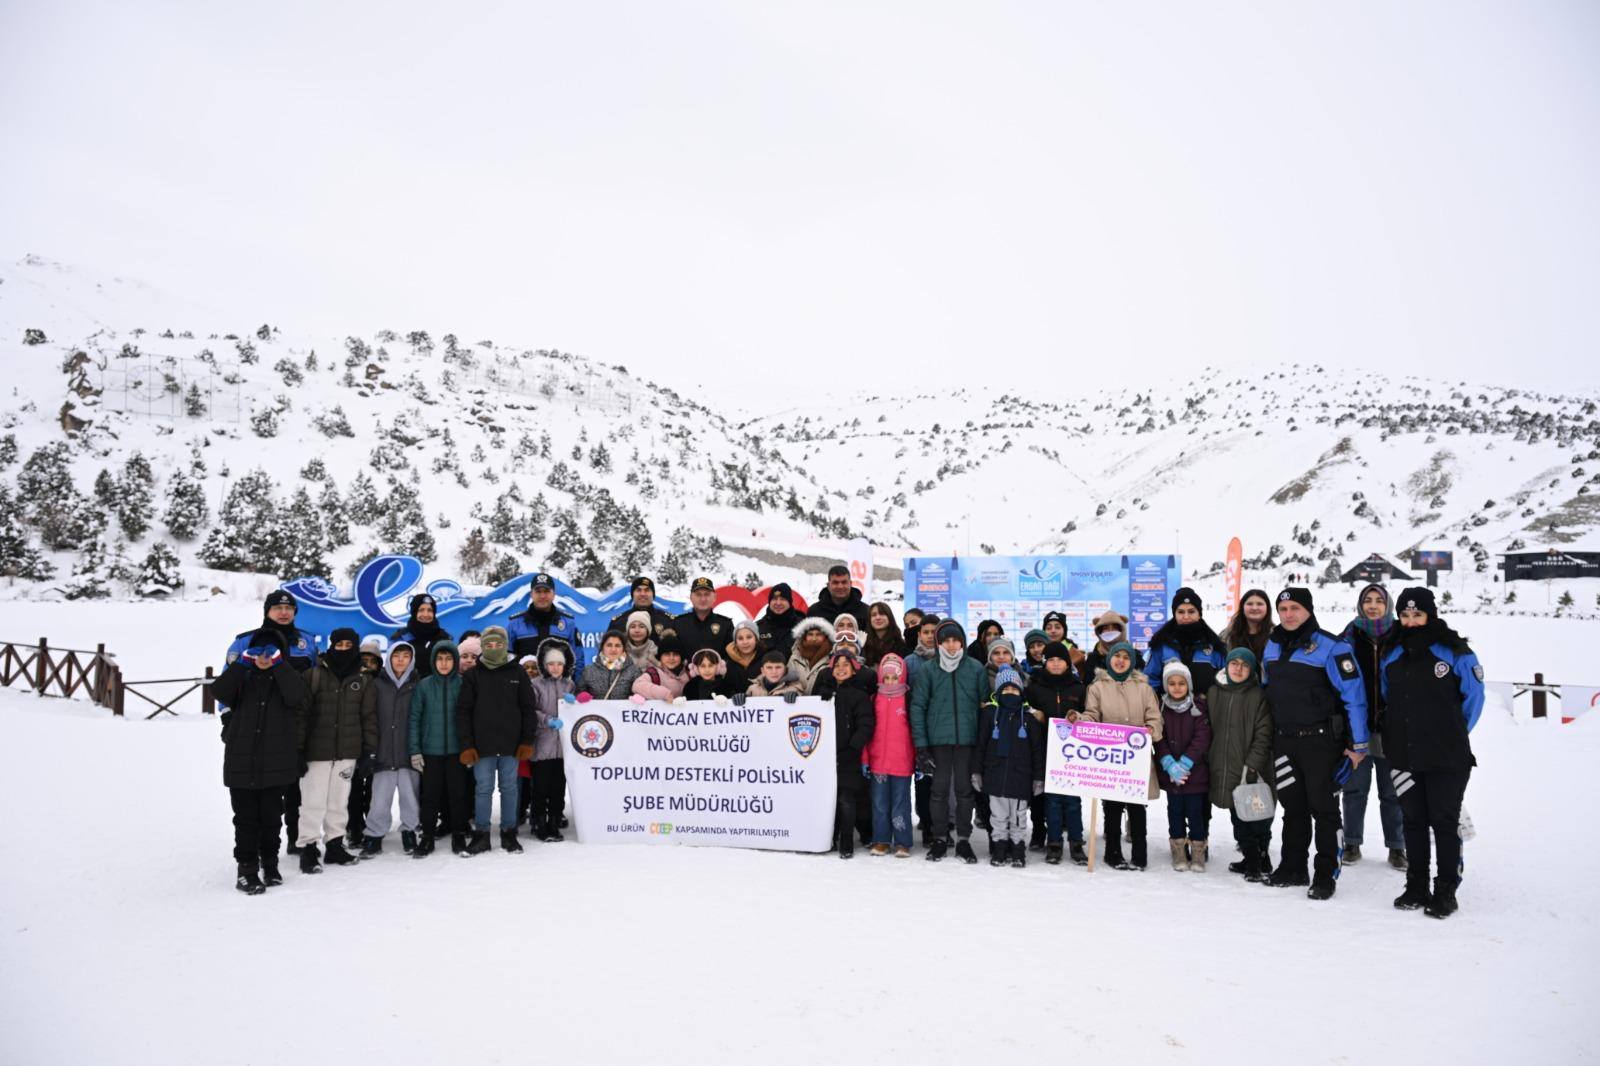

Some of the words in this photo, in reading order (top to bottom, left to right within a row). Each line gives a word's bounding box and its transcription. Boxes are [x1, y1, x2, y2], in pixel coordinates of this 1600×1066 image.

[622, 708, 698, 726] ERZİNCAN
[704, 706, 774, 725] EMNİYET
[1076, 725, 1125, 738] ERZİNCAN
[648, 735, 750, 753] MÜDÜRLÜĞÜ
[1062, 743, 1135, 764] ÇOGEP
[591, 767, 660, 782] TOPLUM
[665, 765, 733, 783] DESTEKLİ
[739, 766, 805, 785] POLİSLİK
[1049, 769, 1075, 778] SOSYAL
[1076, 773, 1107, 782] KORUMA
[1064, 764, 1088, 772] ÇOCUK
[1099, 768, 1131, 777] GENÇLER
[1078, 781, 1115, 789] PROGRAMI
[623, 795, 665, 813] ŞUBE
[669, 793, 773, 814] MÜDÜRLÜĞÜ
[607, 824, 619, 833] BU
[621, 823, 645, 833] ÜRÜN
[676, 825, 727, 835] KAPSAMINDA
[729, 828, 790, 838] YAPTIRILMIŞTIR
